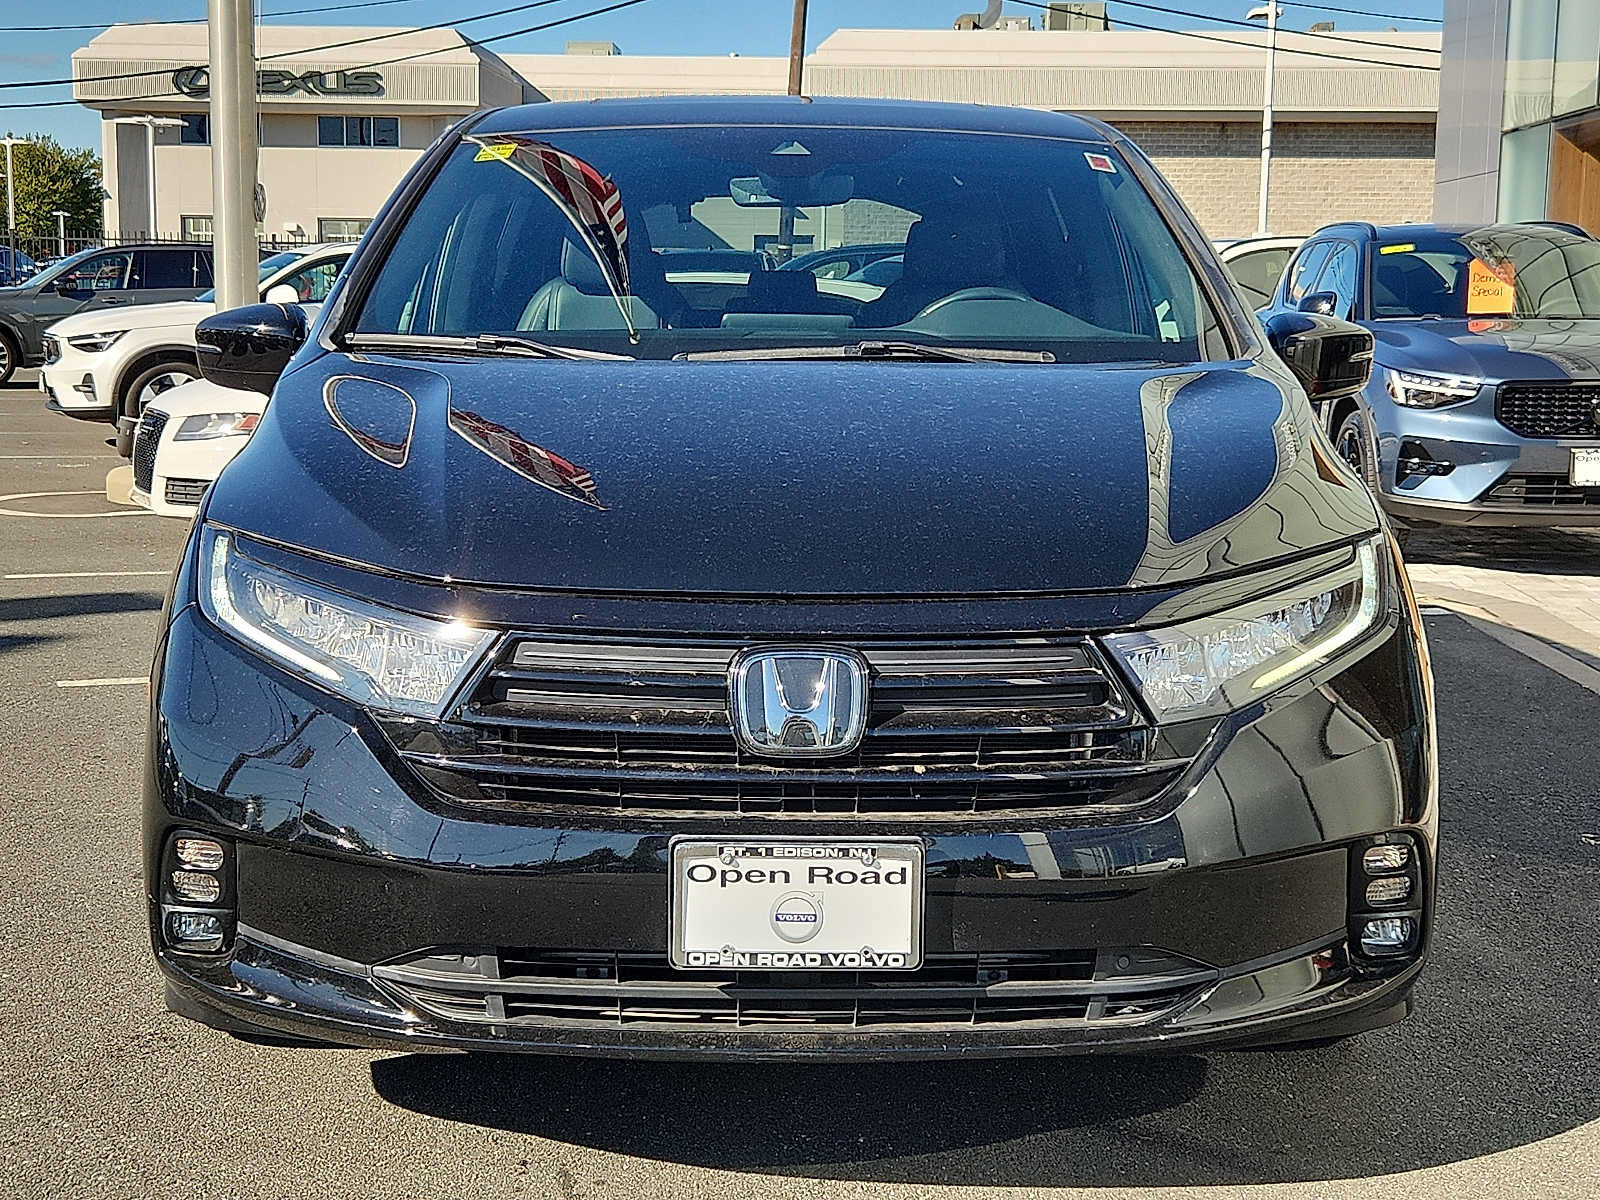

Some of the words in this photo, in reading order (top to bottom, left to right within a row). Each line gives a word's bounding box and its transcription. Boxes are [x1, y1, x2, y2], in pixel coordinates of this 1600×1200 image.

[255, 70, 385, 97] EXUS
[757, 847, 766, 857] 1
[772, 847, 843, 858] EDISON,
[687, 864, 791, 888] Open
[808, 866, 907, 885] Road
[776, 914, 816, 922] VOLVO
[688, 952, 750, 967] OPEN
[757, 952, 823, 967] ROAD
[828, 952, 906, 967] VOLVO
